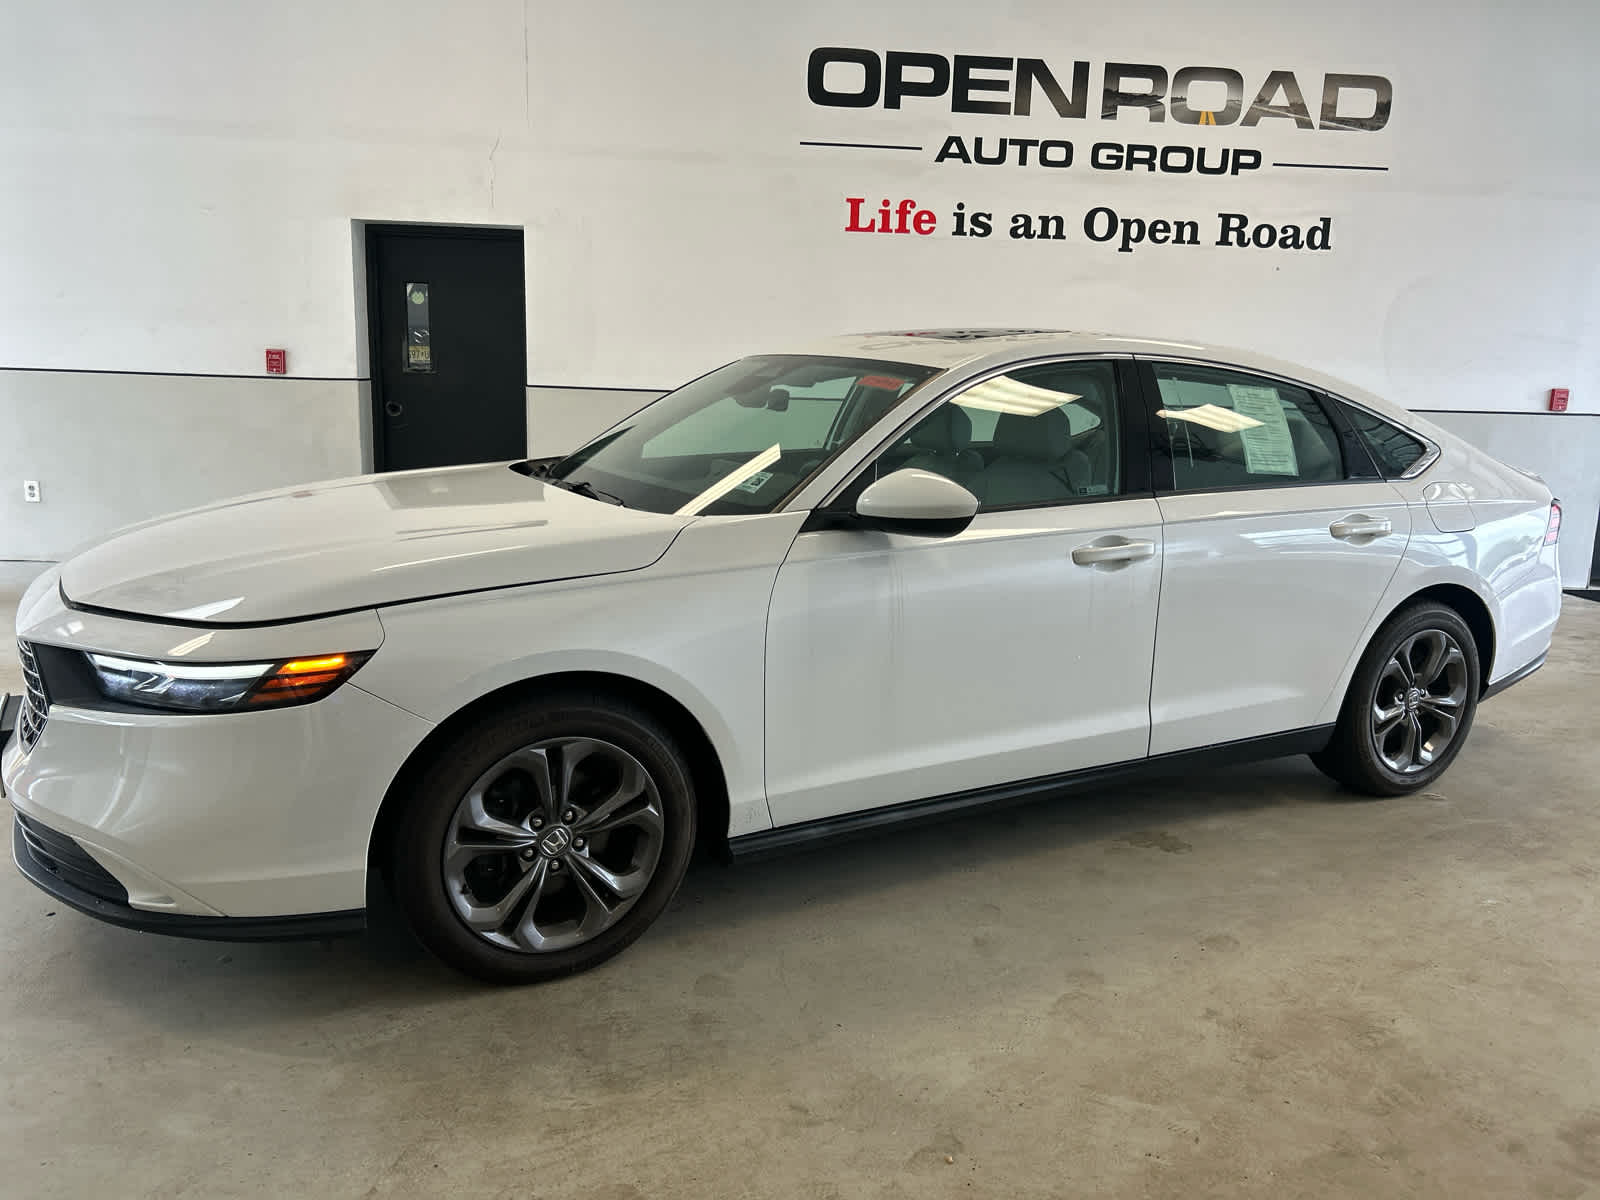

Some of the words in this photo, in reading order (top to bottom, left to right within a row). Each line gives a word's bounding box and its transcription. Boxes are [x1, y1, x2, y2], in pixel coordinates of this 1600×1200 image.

[808, 47, 1090, 119] OPEN
[1101, 62, 1392, 132] ROAD
[934, 136, 1073, 168] AUTO
[1091, 143, 1261, 175] GROUP
[845, 198, 936, 235] Life
[952, 202, 992, 237] is
[1010, 214, 1066, 240] an
[1084, 207, 1200, 252] Open
[1215, 213, 1331, 250] Road
